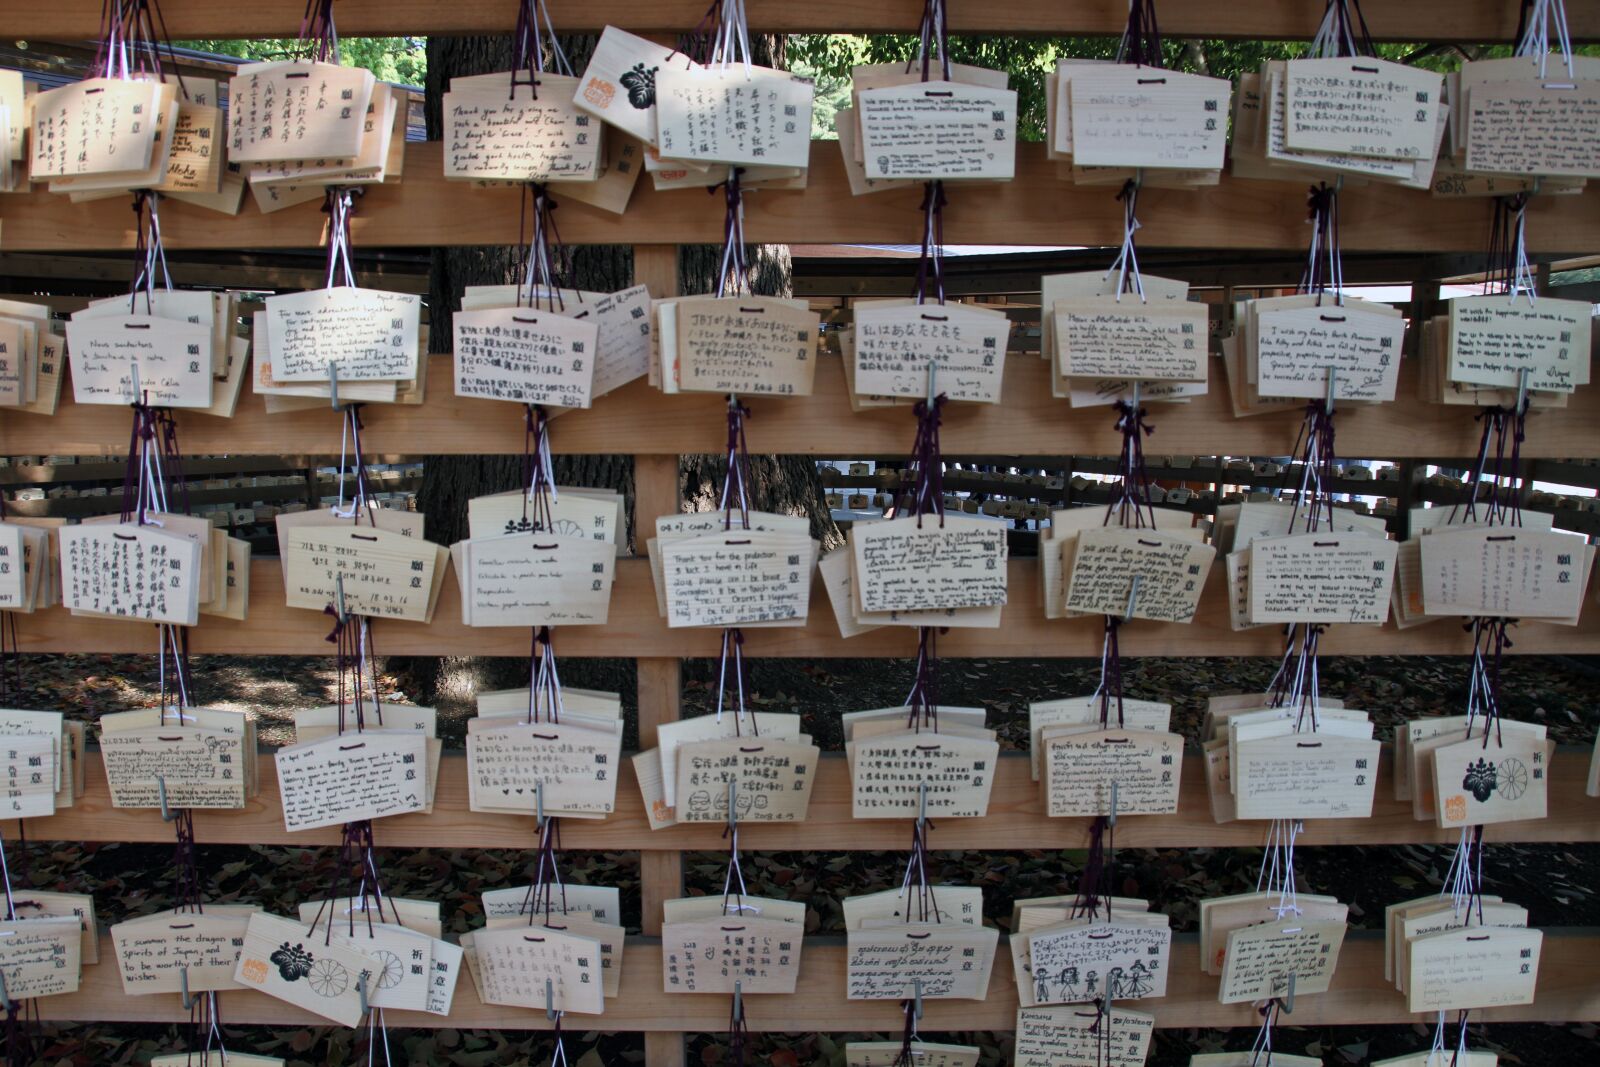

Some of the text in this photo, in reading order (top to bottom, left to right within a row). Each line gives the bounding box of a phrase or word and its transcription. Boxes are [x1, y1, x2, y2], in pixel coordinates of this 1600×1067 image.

[1310, 328, 1327, 339] family
[674, 555, 695, 563] Thank
[745, 552, 776, 560] protection
[121, 939, 126, 947] I
[196, 934, 226, 944] dragon
[123, 949, 152, 959] spirits
[172, 948, 203, 960] Japan,
[125, 963, 134, 971] to
[141, 962, 151, 970] be
[156, 961, 189, 969] worthy
[209, 958, 231, 966] their
